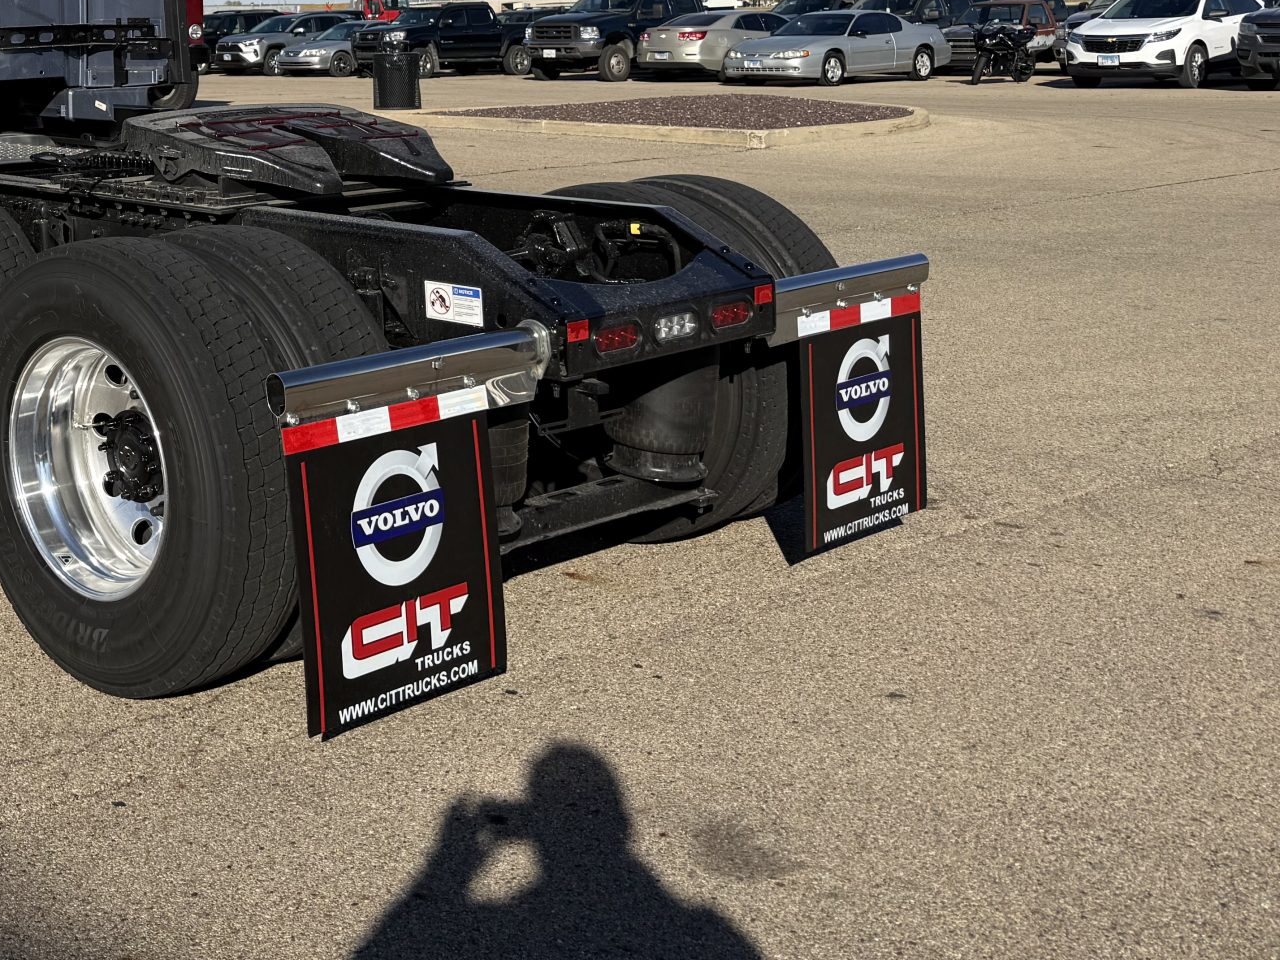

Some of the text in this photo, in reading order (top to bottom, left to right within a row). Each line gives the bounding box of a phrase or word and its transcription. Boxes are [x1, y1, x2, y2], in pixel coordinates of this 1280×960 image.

[839, 377, 889, 402] VOLVO
[826, 442, 905, 510] CIT
[357, 498, 440, 536] VOLVO
[869, 487, 905, 509] TRUCKS
[823, 502, 909, 543] WWW.CITTRUCKS.COM
[341, 581, 469, 680] CIT
[414, 640, 471, 672] TRUCKS
[338, 659, 479, 725] WWW.CITTRUCKS.COM
